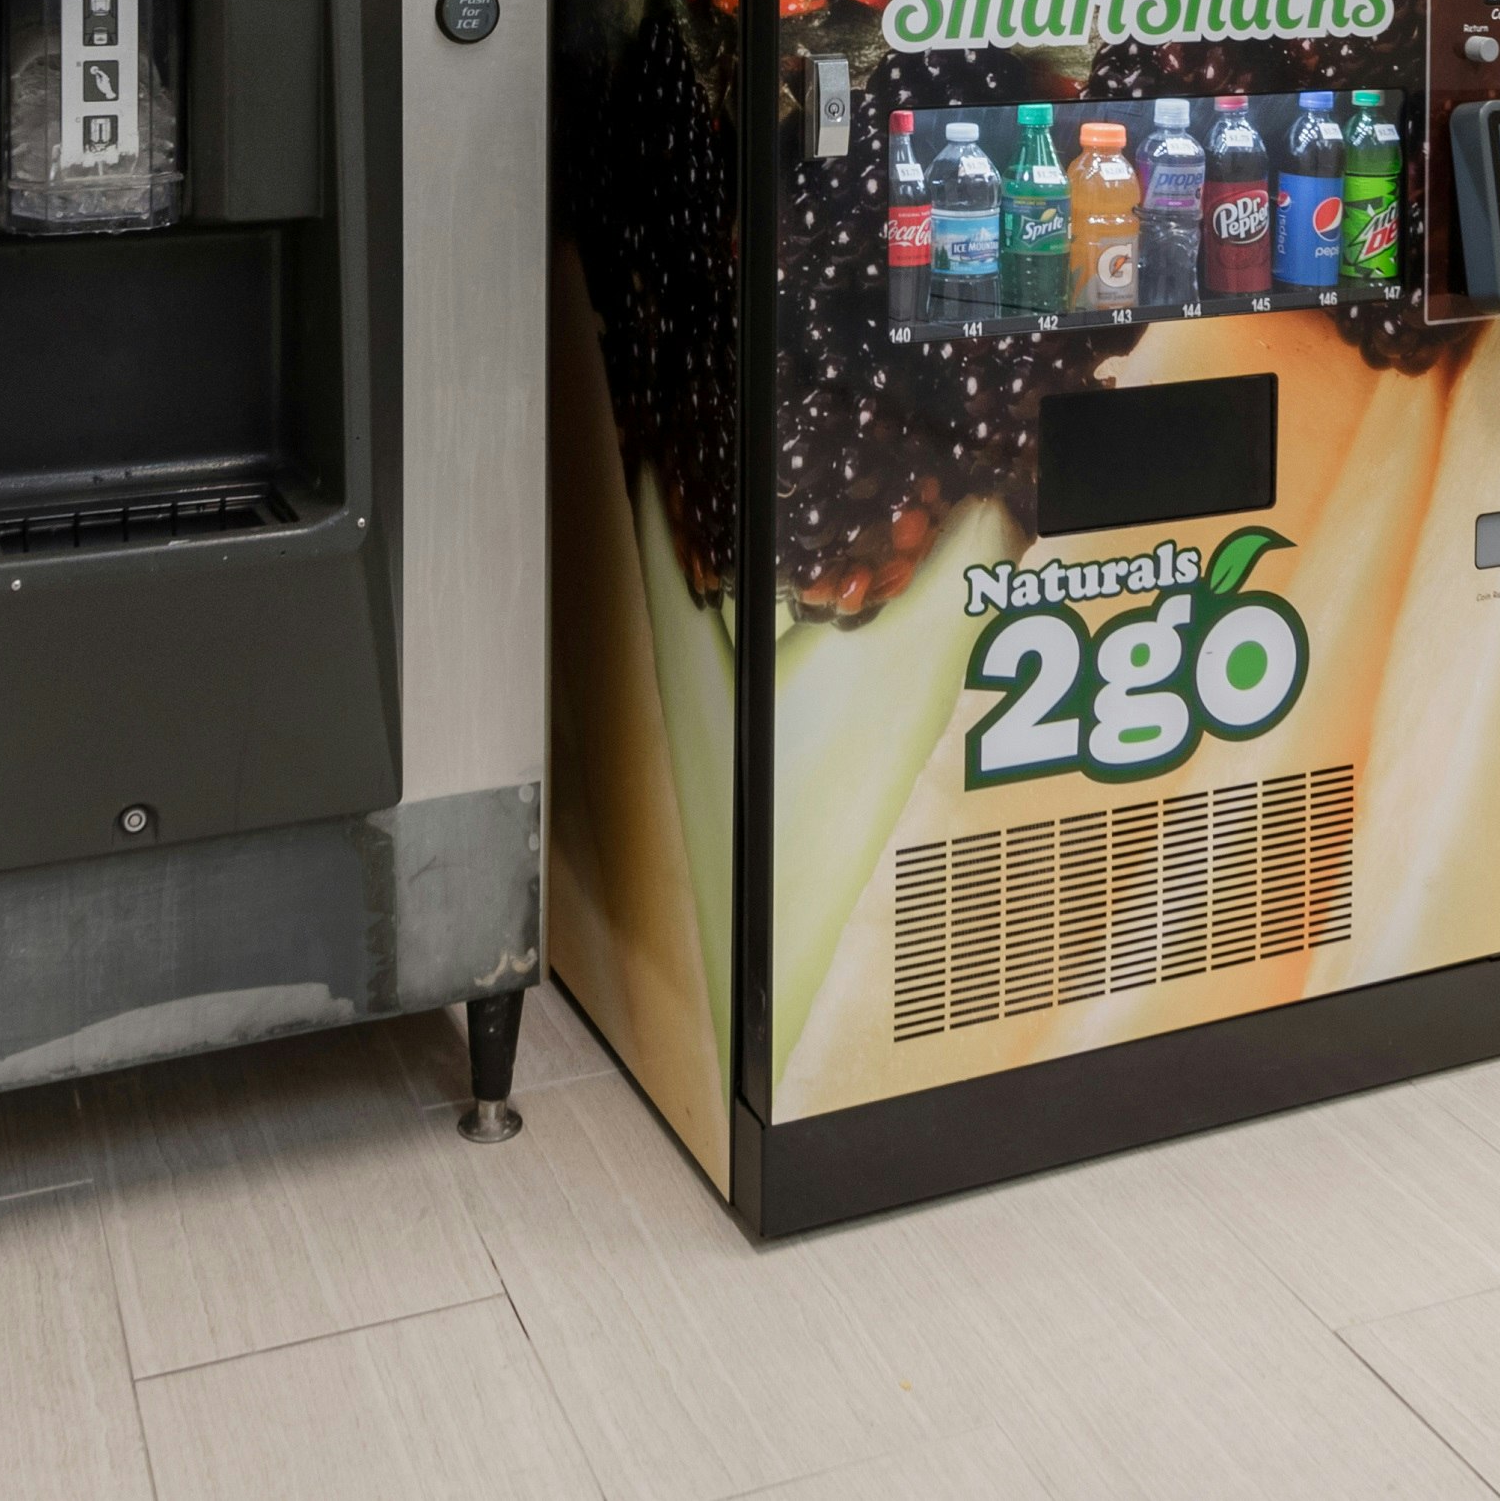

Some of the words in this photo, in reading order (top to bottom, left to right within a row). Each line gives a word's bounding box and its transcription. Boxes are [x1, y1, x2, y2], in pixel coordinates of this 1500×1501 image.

[461, 7, 481, 16] for
[456, 19, 480, 29] ICE
[1463, 23, 1489, 33] Return
[1155, 172, 1203, 189] prope
[1237, 197, 1261, 219] Dr
[1022, 215, 1064, 241] Sprite
[1364, 219, 1397, 256] DE
[953, 244, 967, 253] ICE
[1097, 244, 1132, 287] G
[1318, 292, 1338, 306] 146
[1383, 285, 1401, 300] 147
[1182, 303, 1201, 317] 144
[1251, 298, 1270, 311] 145
[1038, 315, 1058, 330] 142
[1112, 309, 1132, 324] 143
[889, 327, 911, 343] 140
[962, 322, 983, 337] 141
[966, 543, 1199, 614] Naturals
[980, 594, 1297, 773] 2go
